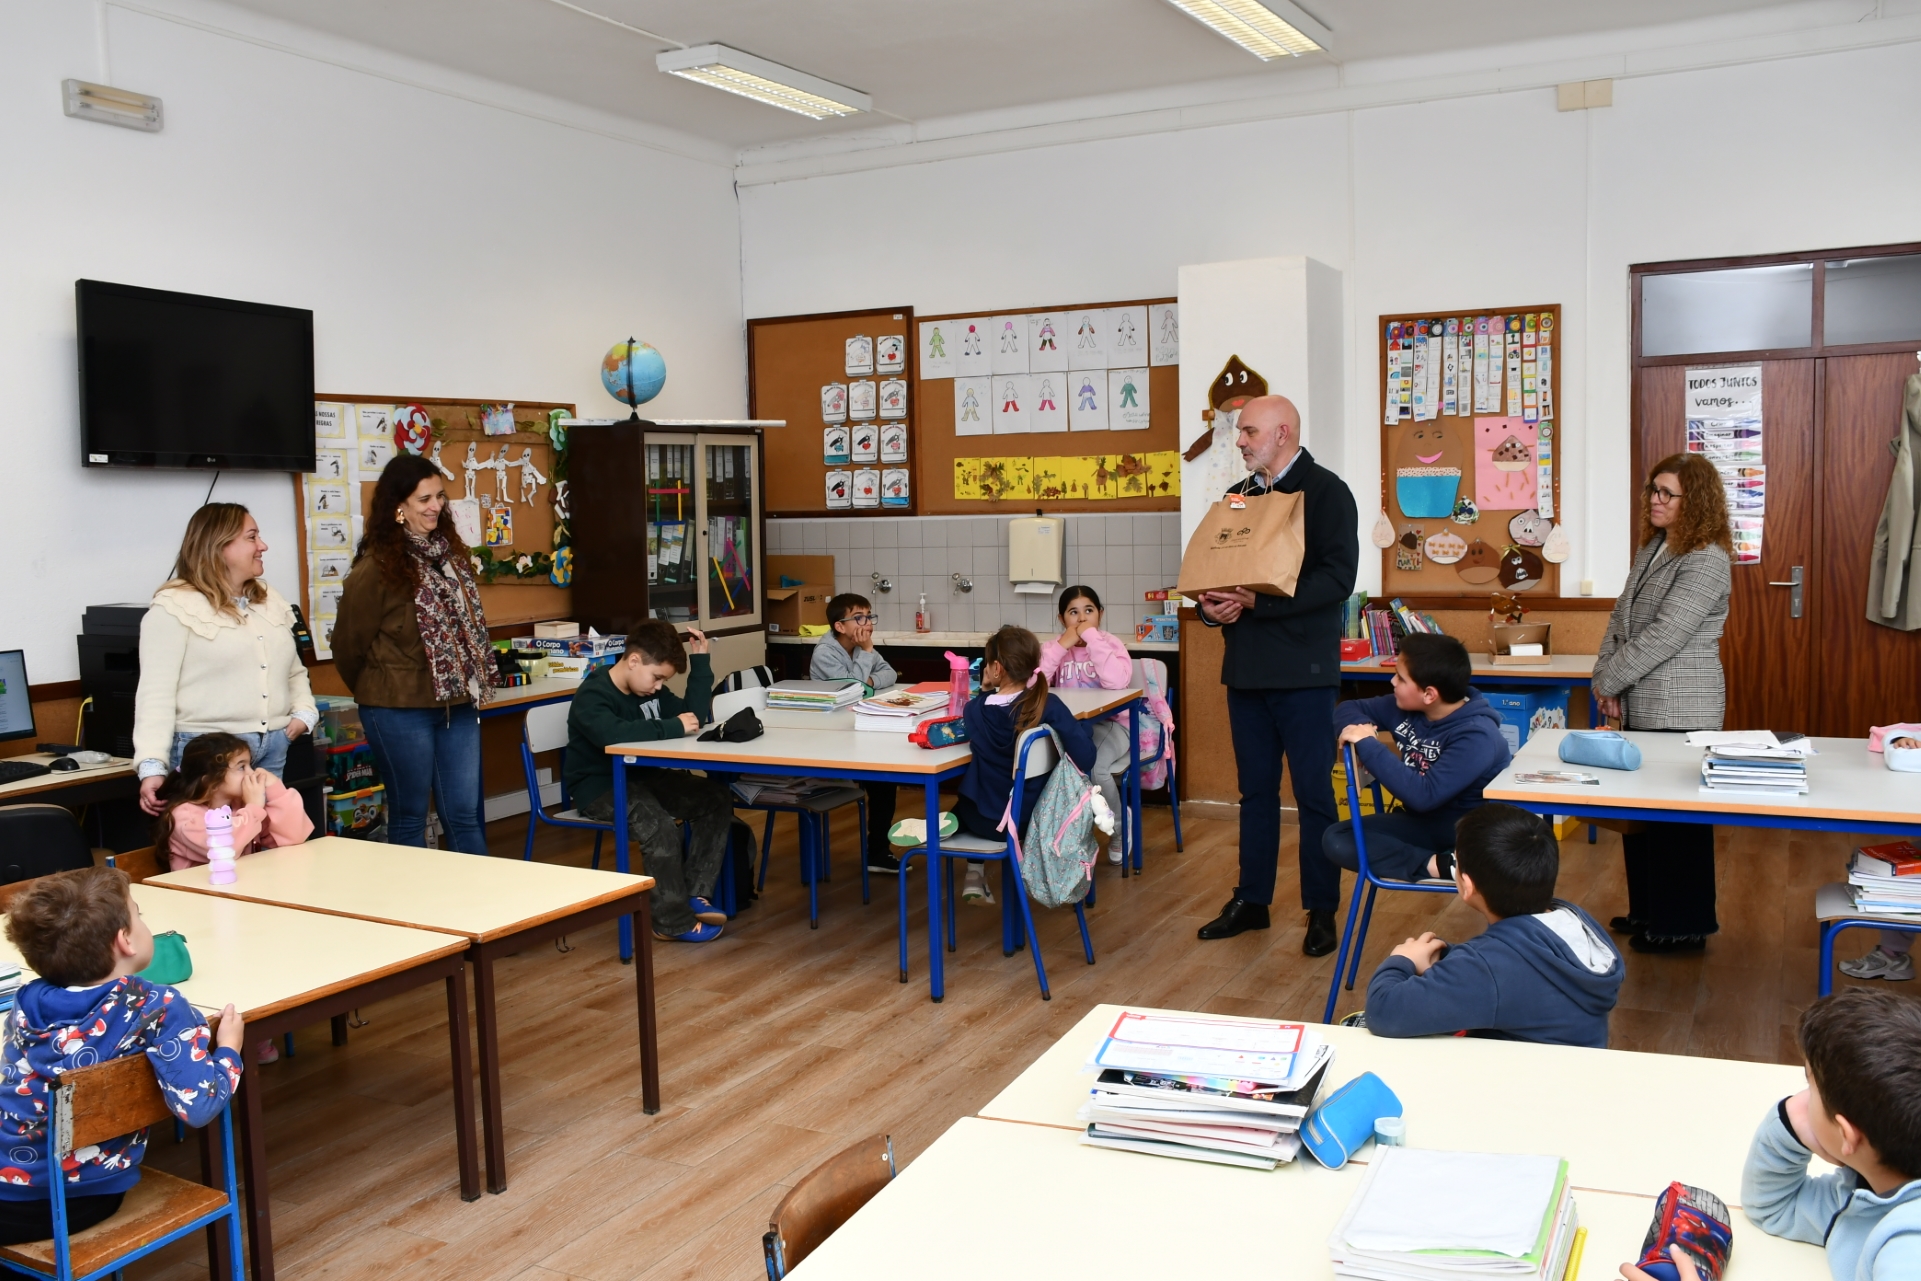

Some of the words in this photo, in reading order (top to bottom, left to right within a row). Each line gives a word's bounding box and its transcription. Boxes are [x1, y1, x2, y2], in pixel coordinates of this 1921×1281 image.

[1688, 378, 1717, 390] TODOS
[1720, 376, 1758, 389] JUNTOS
[316, 419, 333, 427] REGRAS
[536, 640, 542, 648] O
[542, 640, 561, 649] Corpo
[612, 639, 625, 647] Corpo
